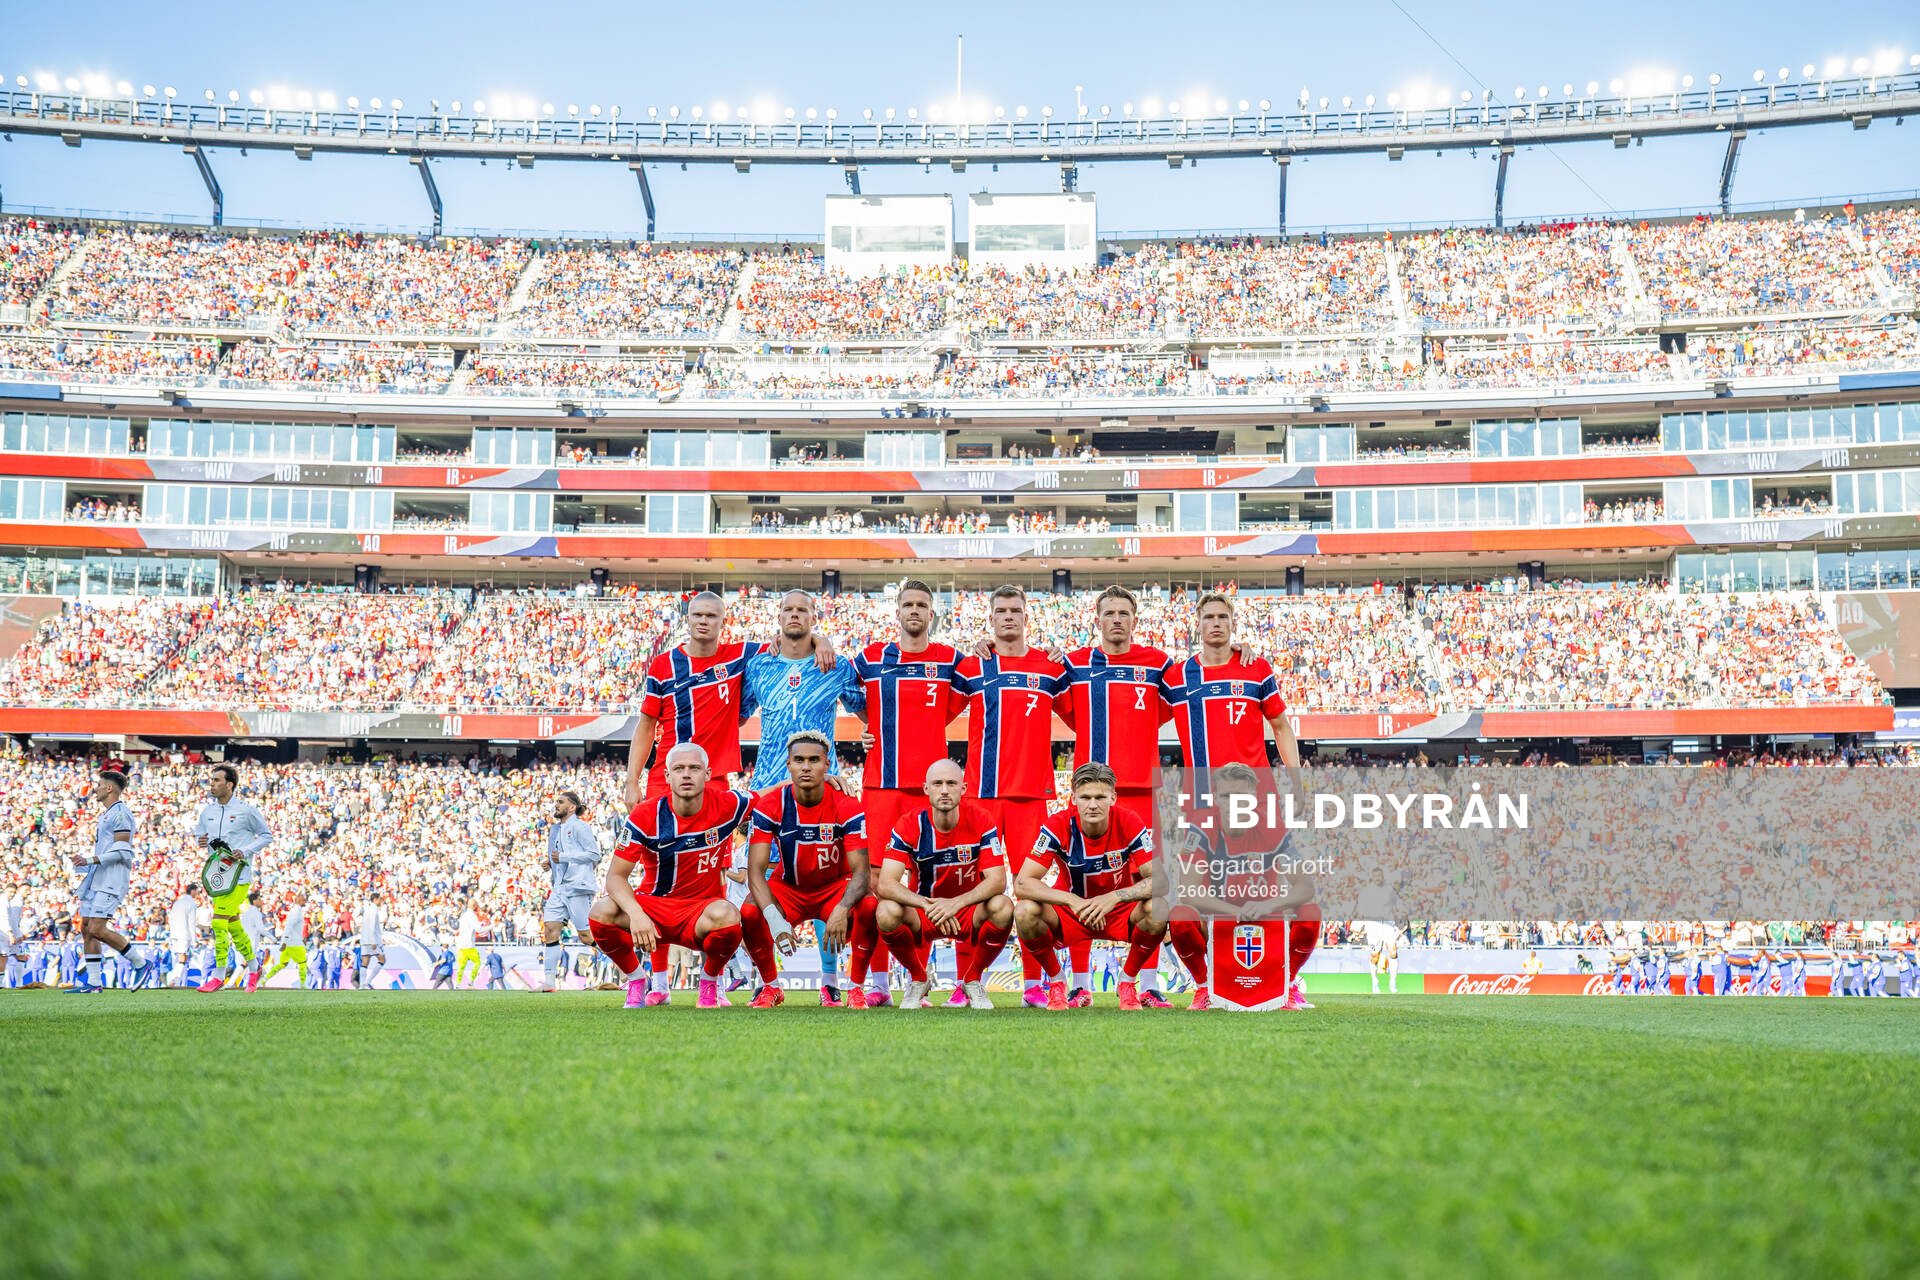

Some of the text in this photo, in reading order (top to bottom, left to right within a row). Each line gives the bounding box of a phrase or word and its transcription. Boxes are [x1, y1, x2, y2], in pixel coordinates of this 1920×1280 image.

[1748, 449, 1850, 471] WAY NOR
[205, 462, 234, 480] WAY
[274, 464, 301, 482] NOR
[446, 468, 459, 486] IR
[968, 471, 996, 489] WAY
[1035, 471, 1060, 489] NOR
[1203, 469, 1216, 486] IR
[444, 536, 457, 552] IR
[1204, 537, 1217, 553] IR
[717, 683, 730, 705] 9
[926, 683, 938, 707] 3
[1025, 693, 1039, 717] 7
[1134, 687, 1147, 711] 8
[790, 697, 797, 720] 1
[1226, 701, 1248, 725] 17
[257, 713, 292, 734] WAY
[340, 715, 370, 736] NOR
[538, 717, 553, 737] IR
[1378, 715, 1393, 736] IR
[697, 847, 721, 874] 26
[816, 845, 840, 870] 20
[955, 865, 976, 886] 14
